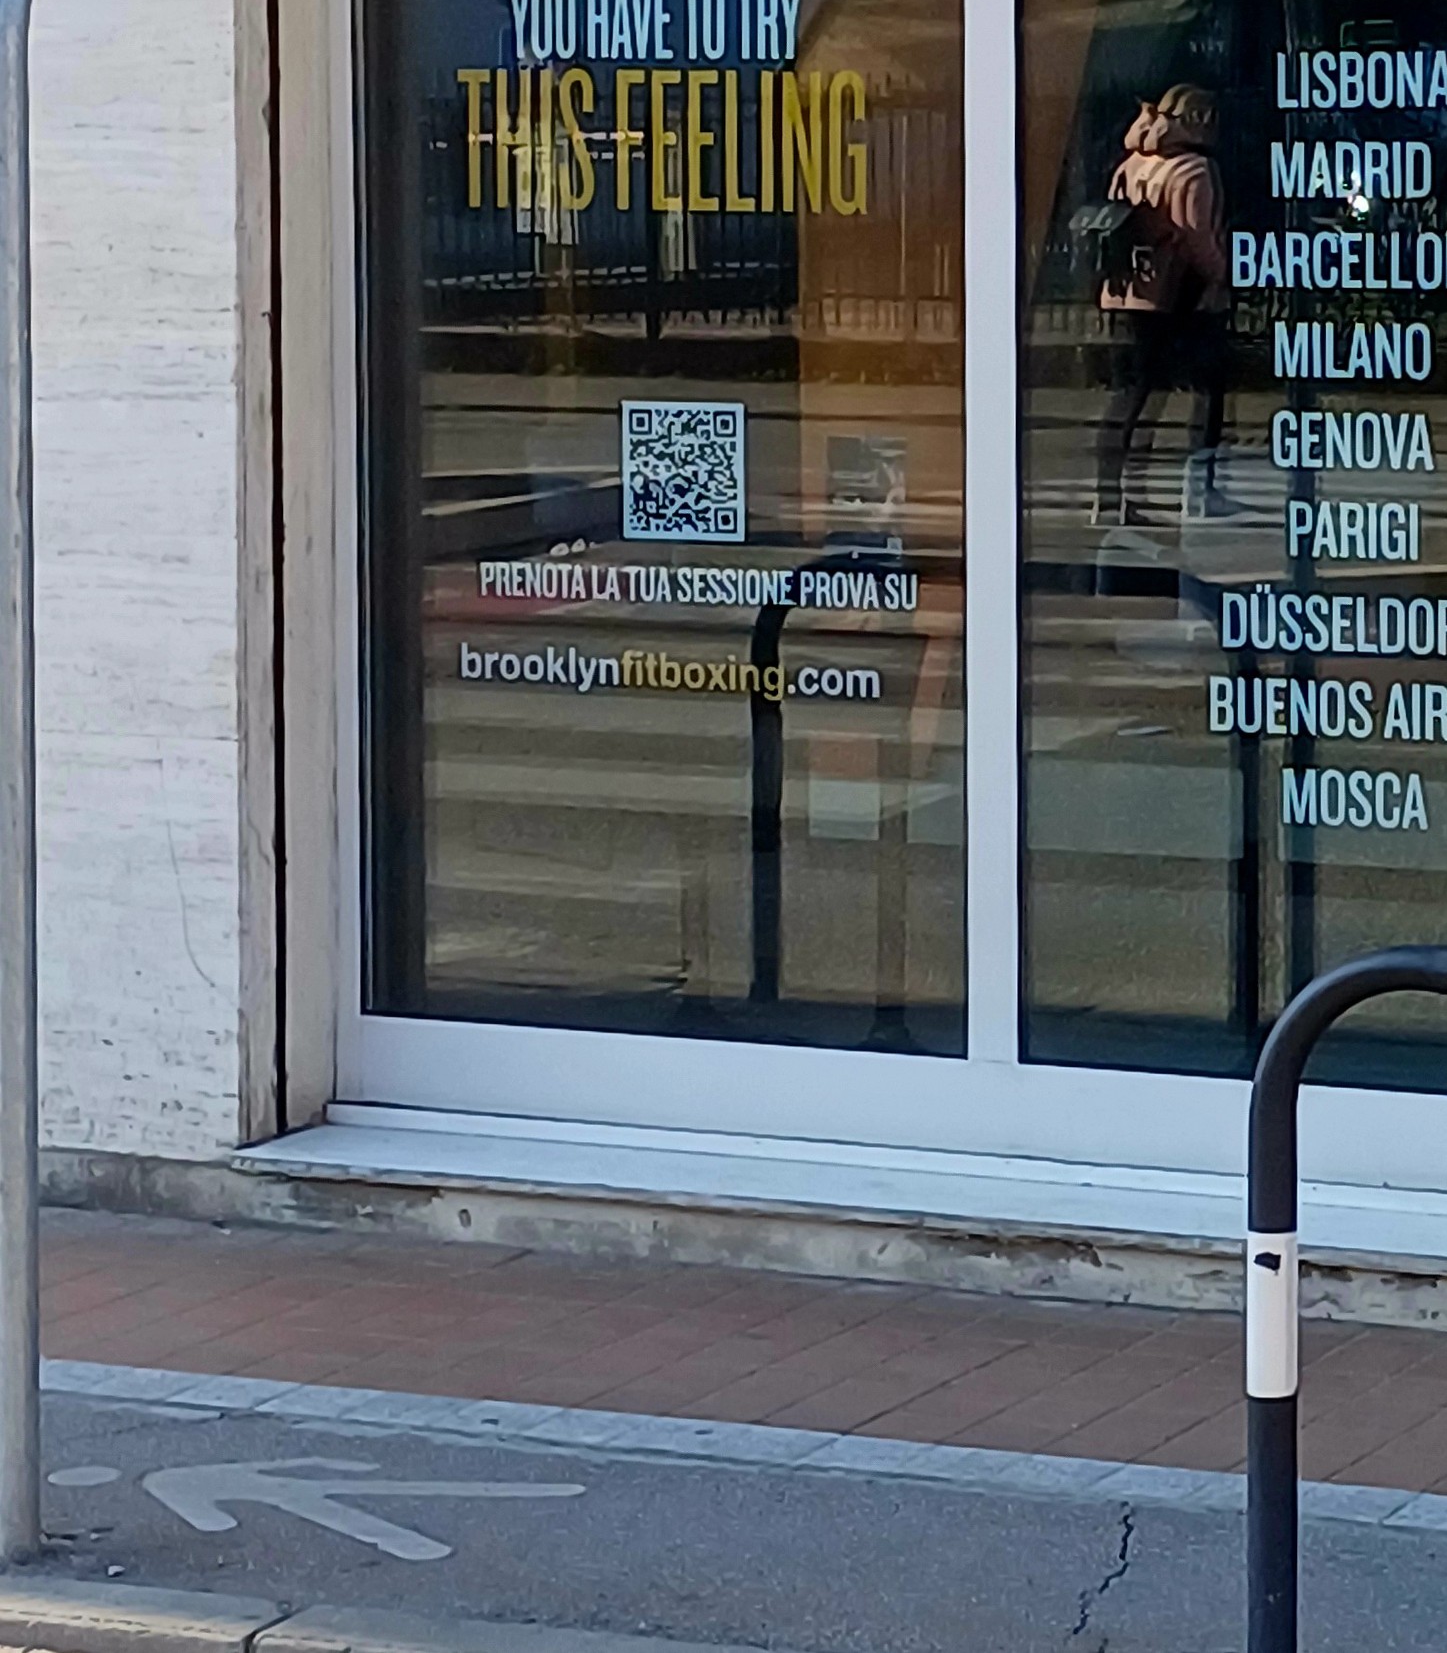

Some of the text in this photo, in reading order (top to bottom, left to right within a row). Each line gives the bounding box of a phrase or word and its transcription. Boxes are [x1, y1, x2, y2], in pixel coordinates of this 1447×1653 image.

[457, 67, 868, 215] THIS FEELING
[1271, 141, 1432, 199] MADRID
[1273, 320, 1432, 380] MILANO
[1272, 410, 1435, 470] GENOVA
[1288, 500, 1419, 560] PARIGI
[480, 561, 918, 611] PRENOTA LA TUA SESSIONE PROVA SU
[460, 642, 881, 701] brooklynfitboxing.com
[1209, 675, 1374, 738] BUENOS
[1281, 767, 1429, 830] MOSCA
